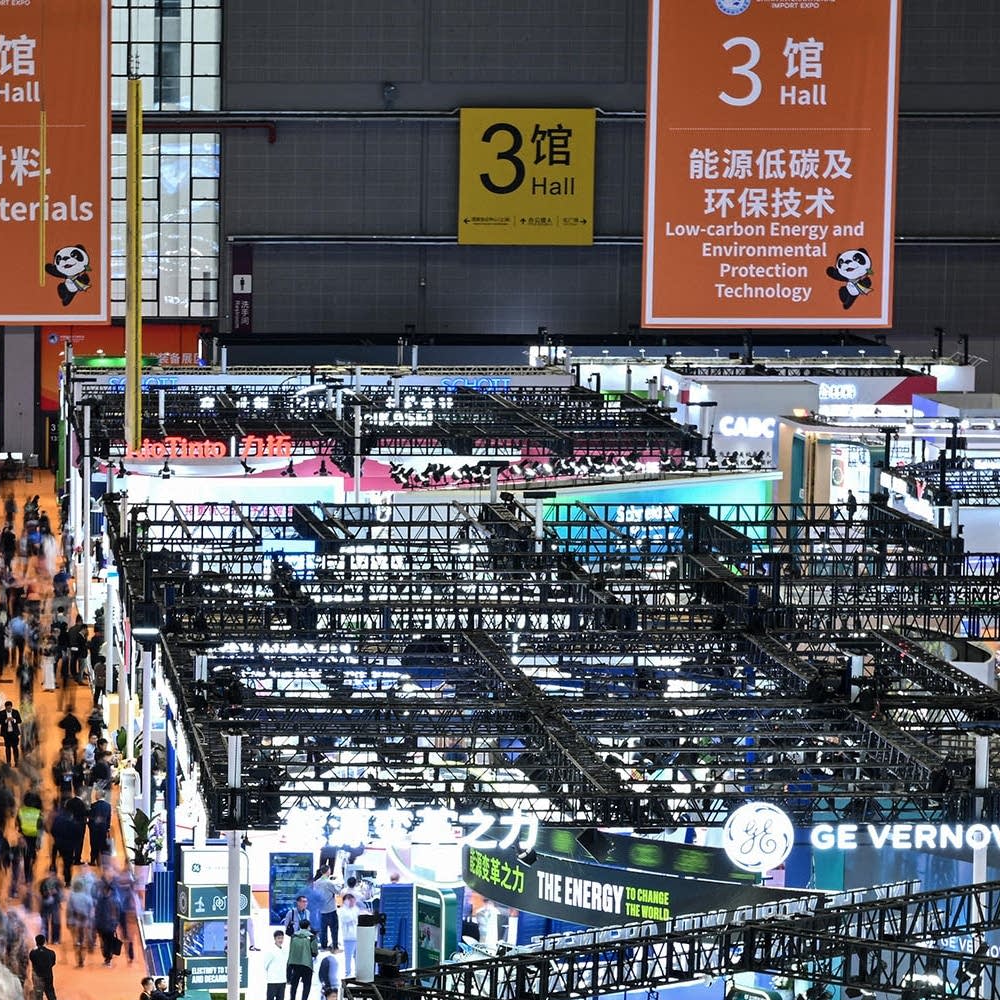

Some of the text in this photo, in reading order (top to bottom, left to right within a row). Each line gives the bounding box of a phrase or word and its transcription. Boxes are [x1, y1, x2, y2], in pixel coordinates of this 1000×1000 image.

[718, 36, 825, 107] 3 馆
[779, 84, 827, 106] Hall
[479, 122, 573, 195] 3 馆
[688, 147, 853, 181] 能源低碳及
[531, 177, 575, 196] Hall
[703, 187, 836, 219] 环保技术
[665, 221, 865, 240] Low-carbon Energy and
[702, 242, 828, 258] Environmental
[719, 263, 808, 279] Protection
[715, 283, 812, 302] Technology
[810, 823, 858, 850] GE
[536, 870, 625, 915] THE ENERGY
[625, 886, 670, 904] TO CHANGE
[625, 902, 670, 921] THE WORLD
